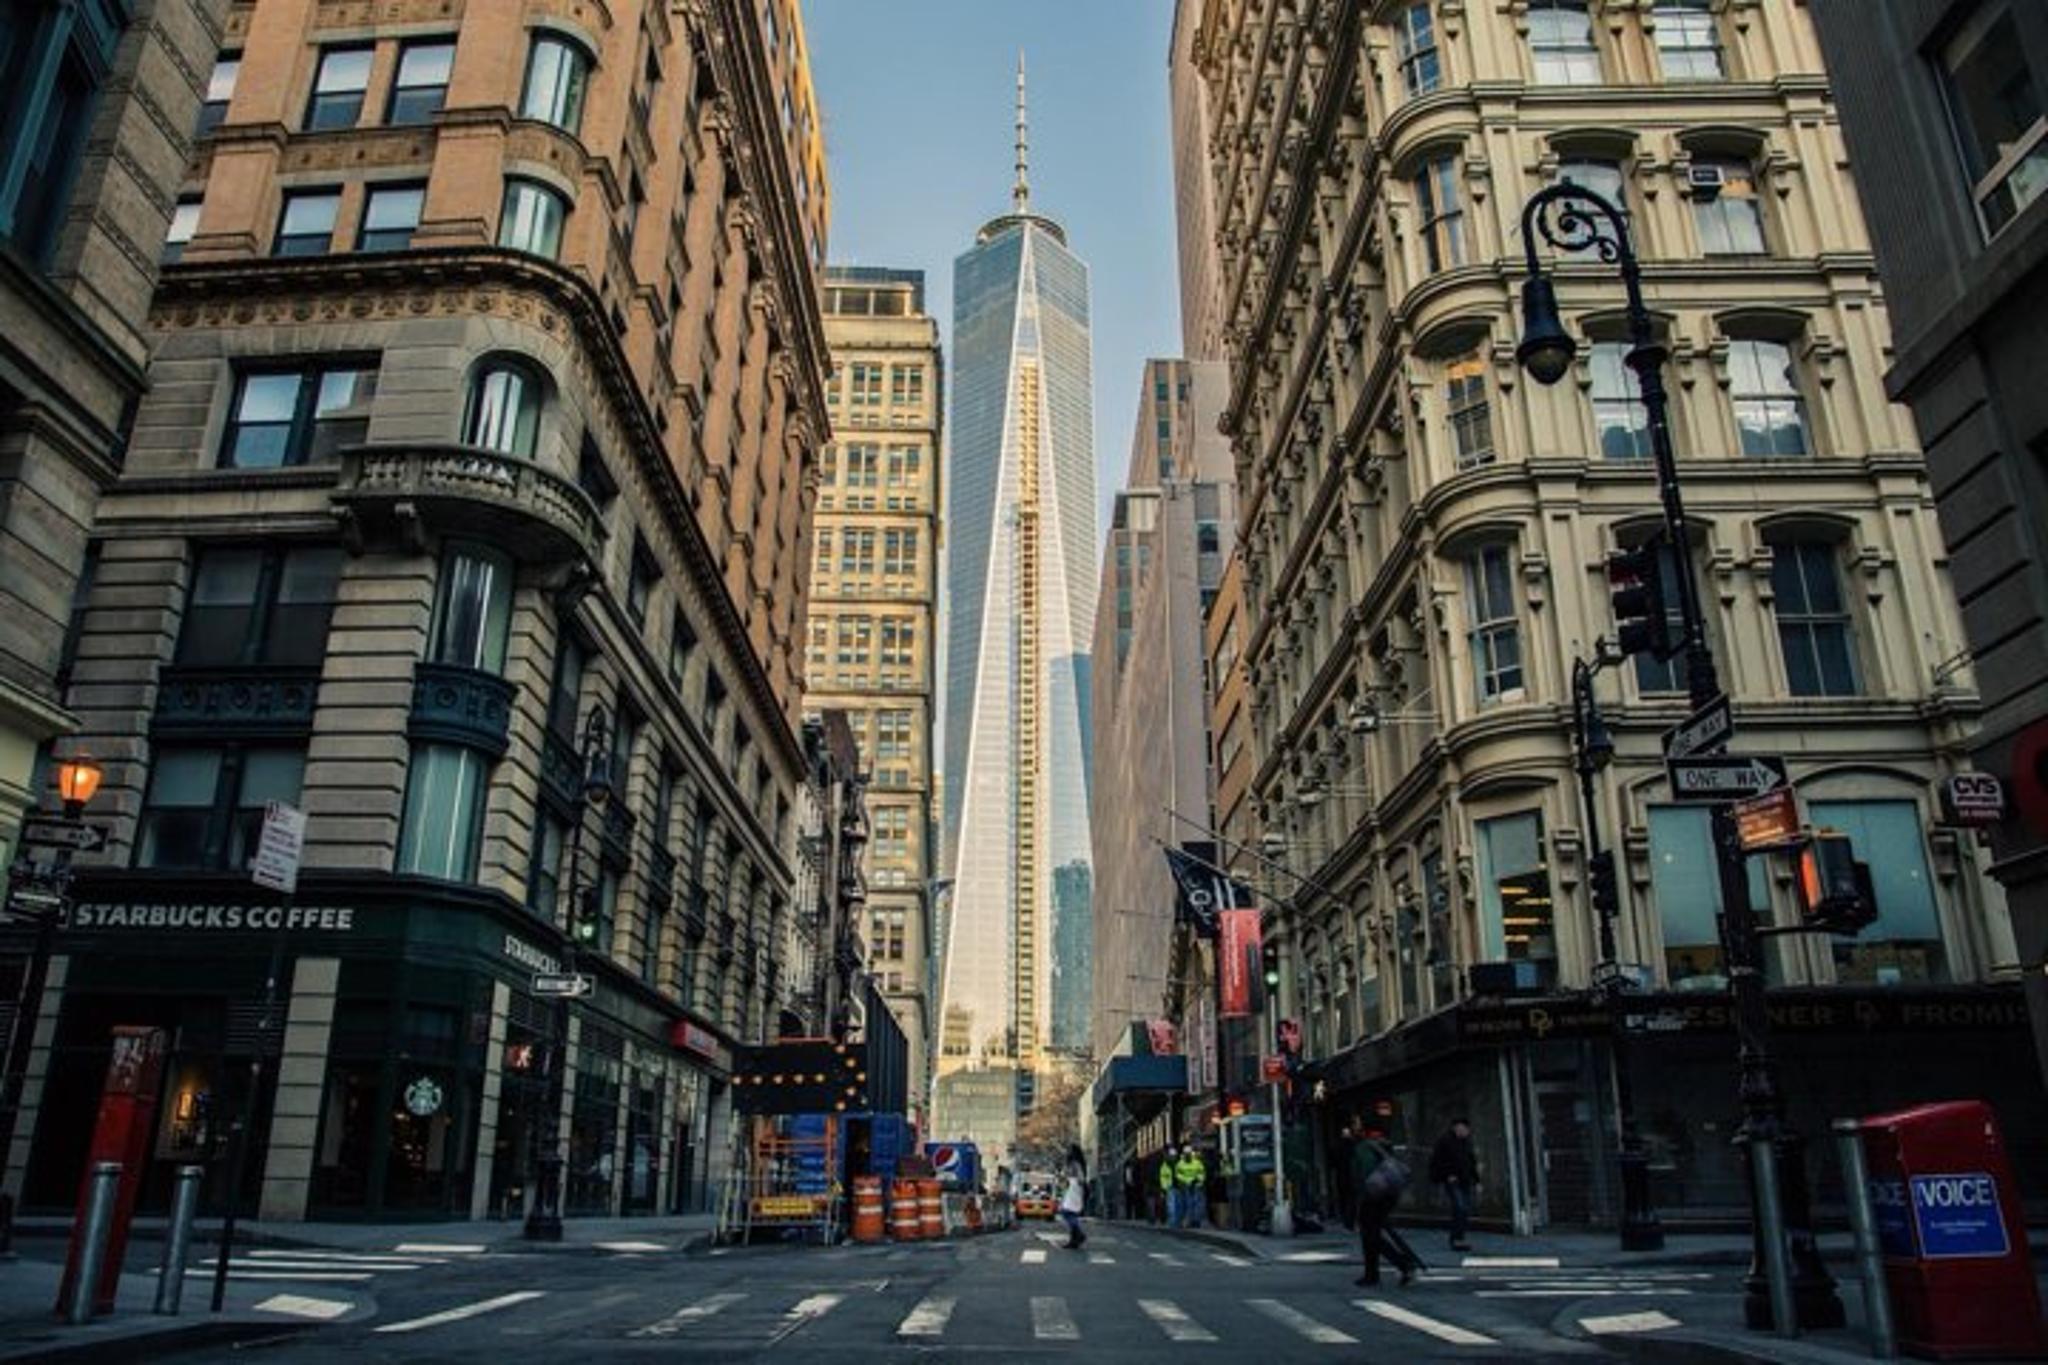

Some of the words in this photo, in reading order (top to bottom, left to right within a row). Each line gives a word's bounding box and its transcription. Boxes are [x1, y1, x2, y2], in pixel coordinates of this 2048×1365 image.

[1686, 770, 1718, 786] ONE
[1736, 770, 1768, 786] WAY
[1954, 777, 1996, 794] CVS
[75, 902, 243, 928] STARBUCKS
[246, 905, 355, 930] COFFEE
[1919, 1179, 1992, 1208] VOICE
